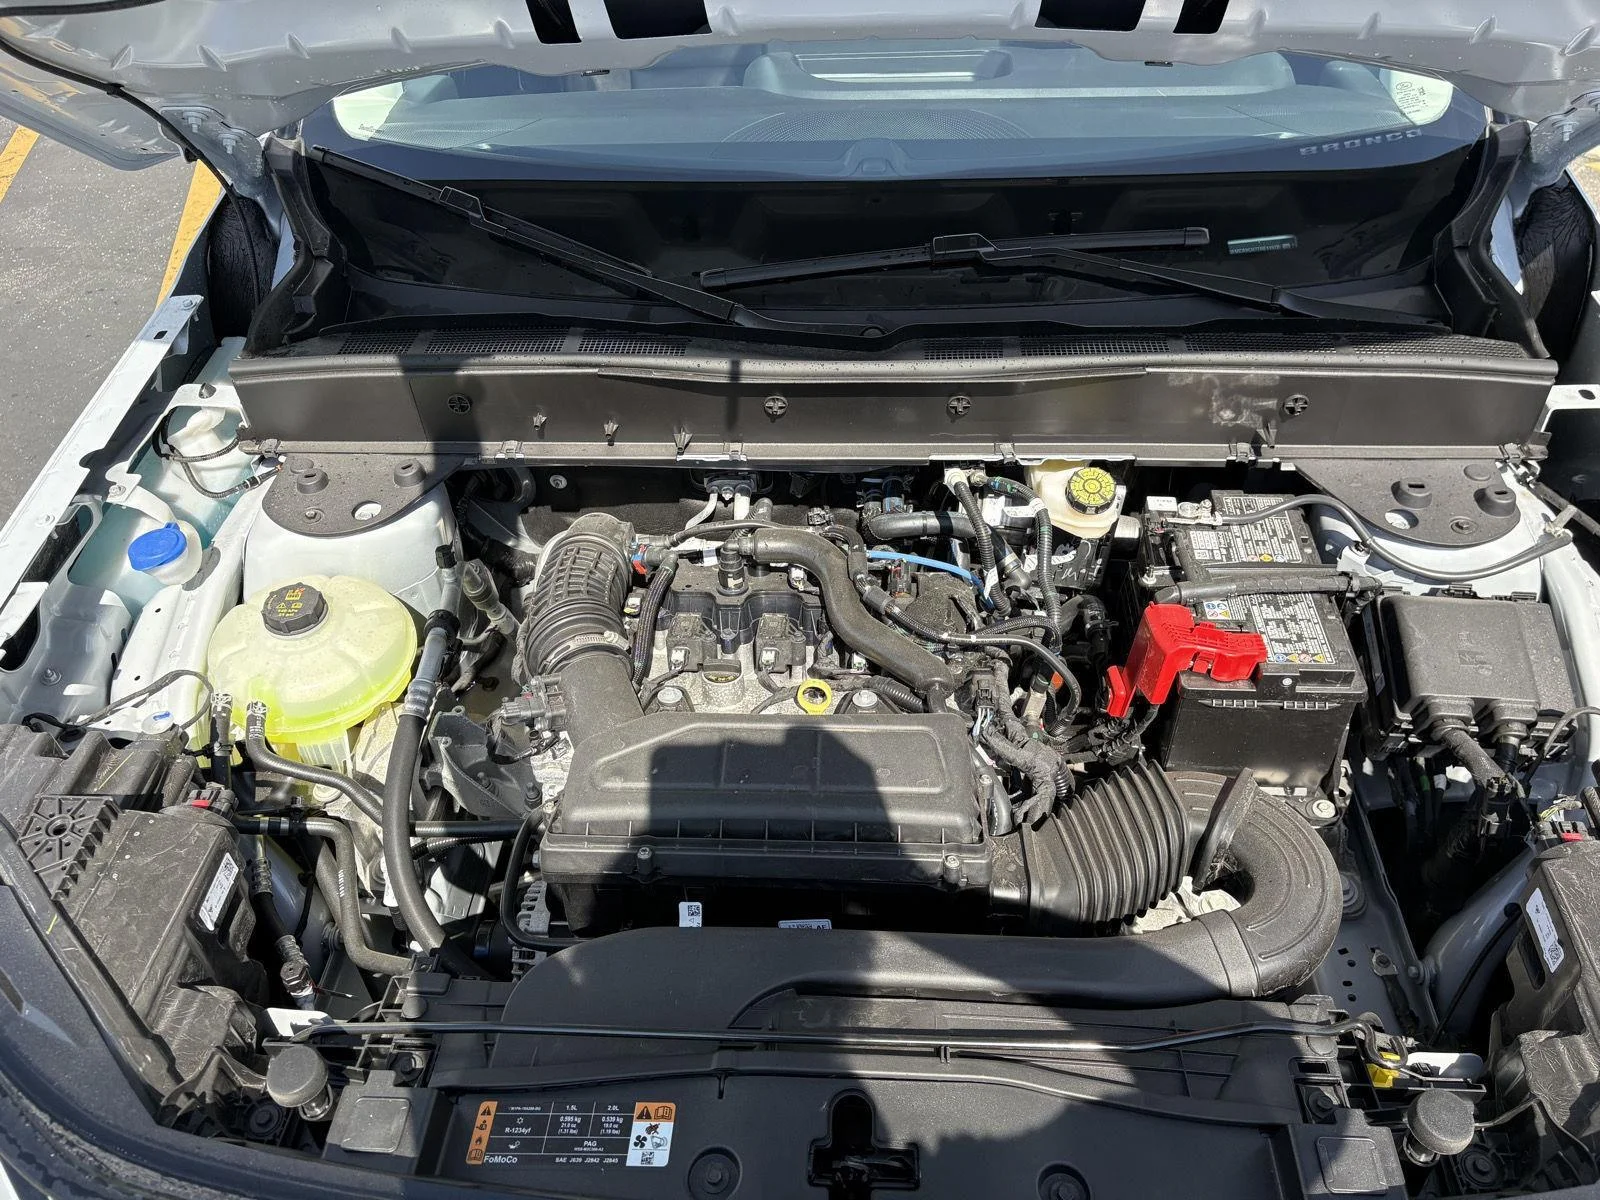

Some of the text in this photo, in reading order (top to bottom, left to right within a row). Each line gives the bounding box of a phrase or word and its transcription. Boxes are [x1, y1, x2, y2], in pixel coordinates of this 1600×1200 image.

[1299, 128, 1423, 156] BRONCO
[504, 1127, 532, 1135] R-1234yf
[483, 1155, 518, 1163] FoMoCo
